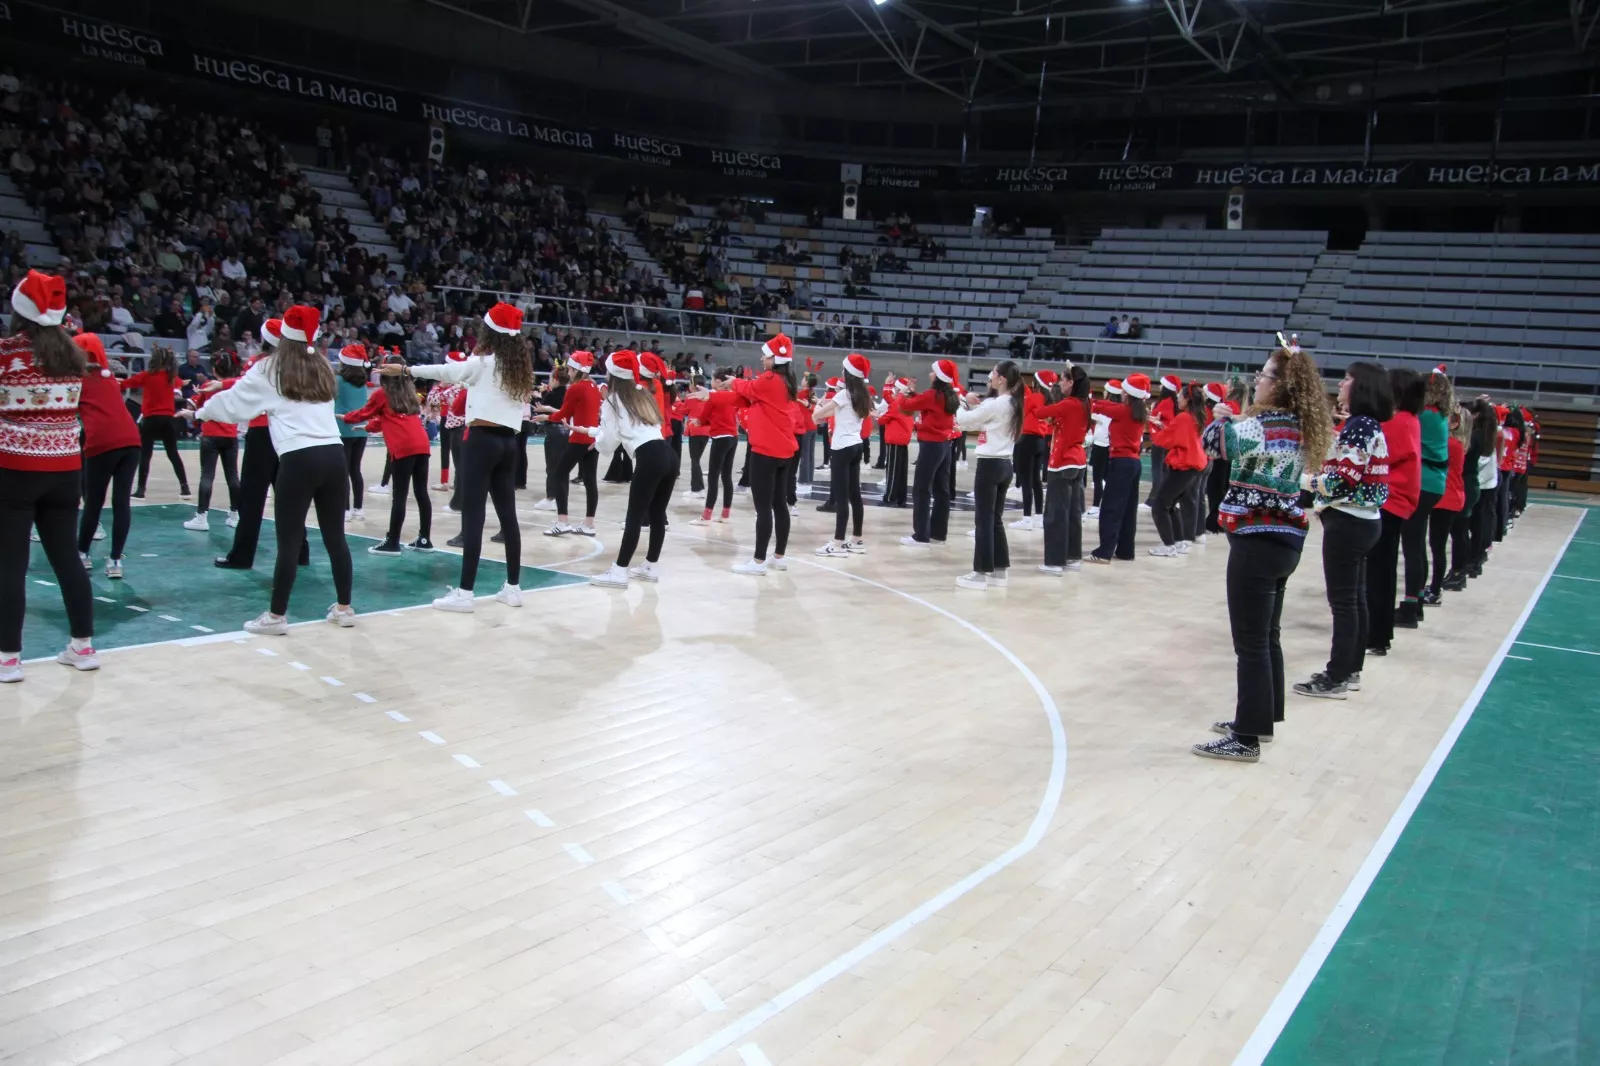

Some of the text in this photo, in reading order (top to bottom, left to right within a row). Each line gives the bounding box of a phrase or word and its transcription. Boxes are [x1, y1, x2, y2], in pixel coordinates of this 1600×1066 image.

[193, 54, 291, 91] Huesca
[297, 77, 325, 97] La
[422, 103, 502, 133] Huesca
[506, 120, 529, 137] La
[1290, 167, 1316, 184] La
[1539, 165, 1569, 182] La
[881, 177, 920, 188] Huesca
